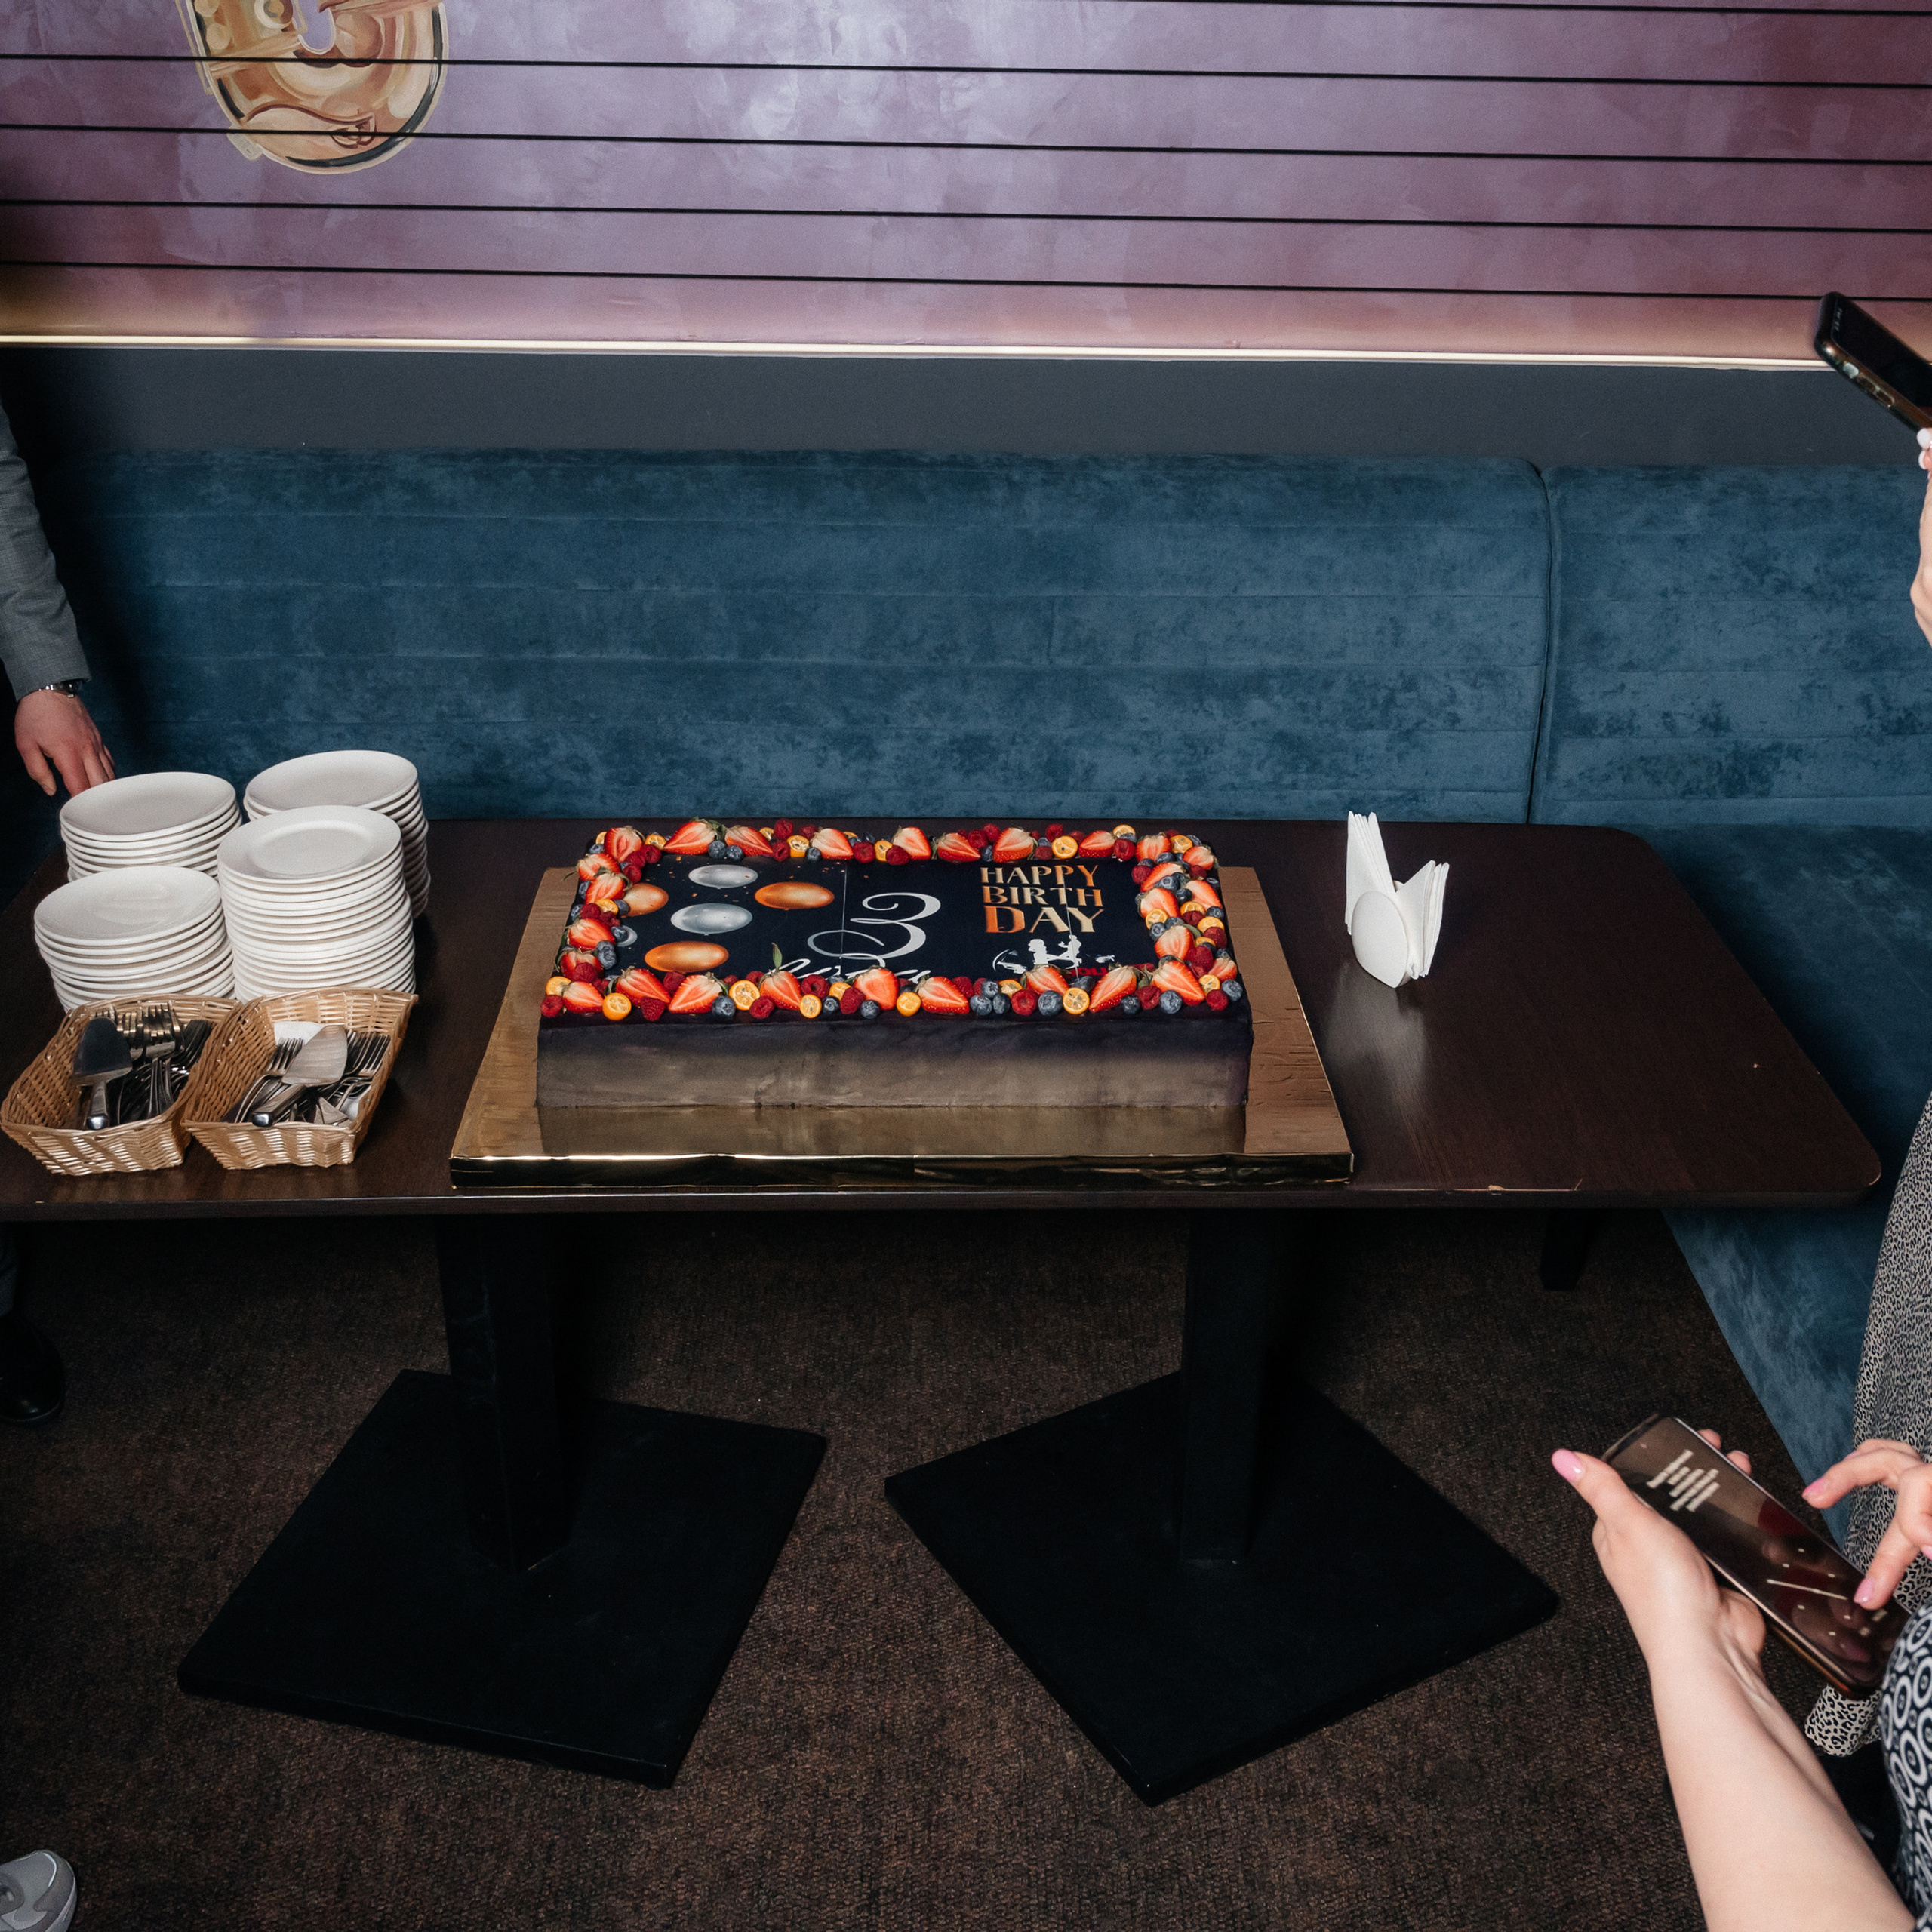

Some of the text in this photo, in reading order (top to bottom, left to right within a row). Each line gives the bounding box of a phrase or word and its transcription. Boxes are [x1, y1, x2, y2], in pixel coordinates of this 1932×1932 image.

[981, 865, 1098, 887] HAPPY
[983, 885, 1103, 906] BIRTH
[808, 892, 941, 960] 3
[984, 906, 1104, 933] DAY
